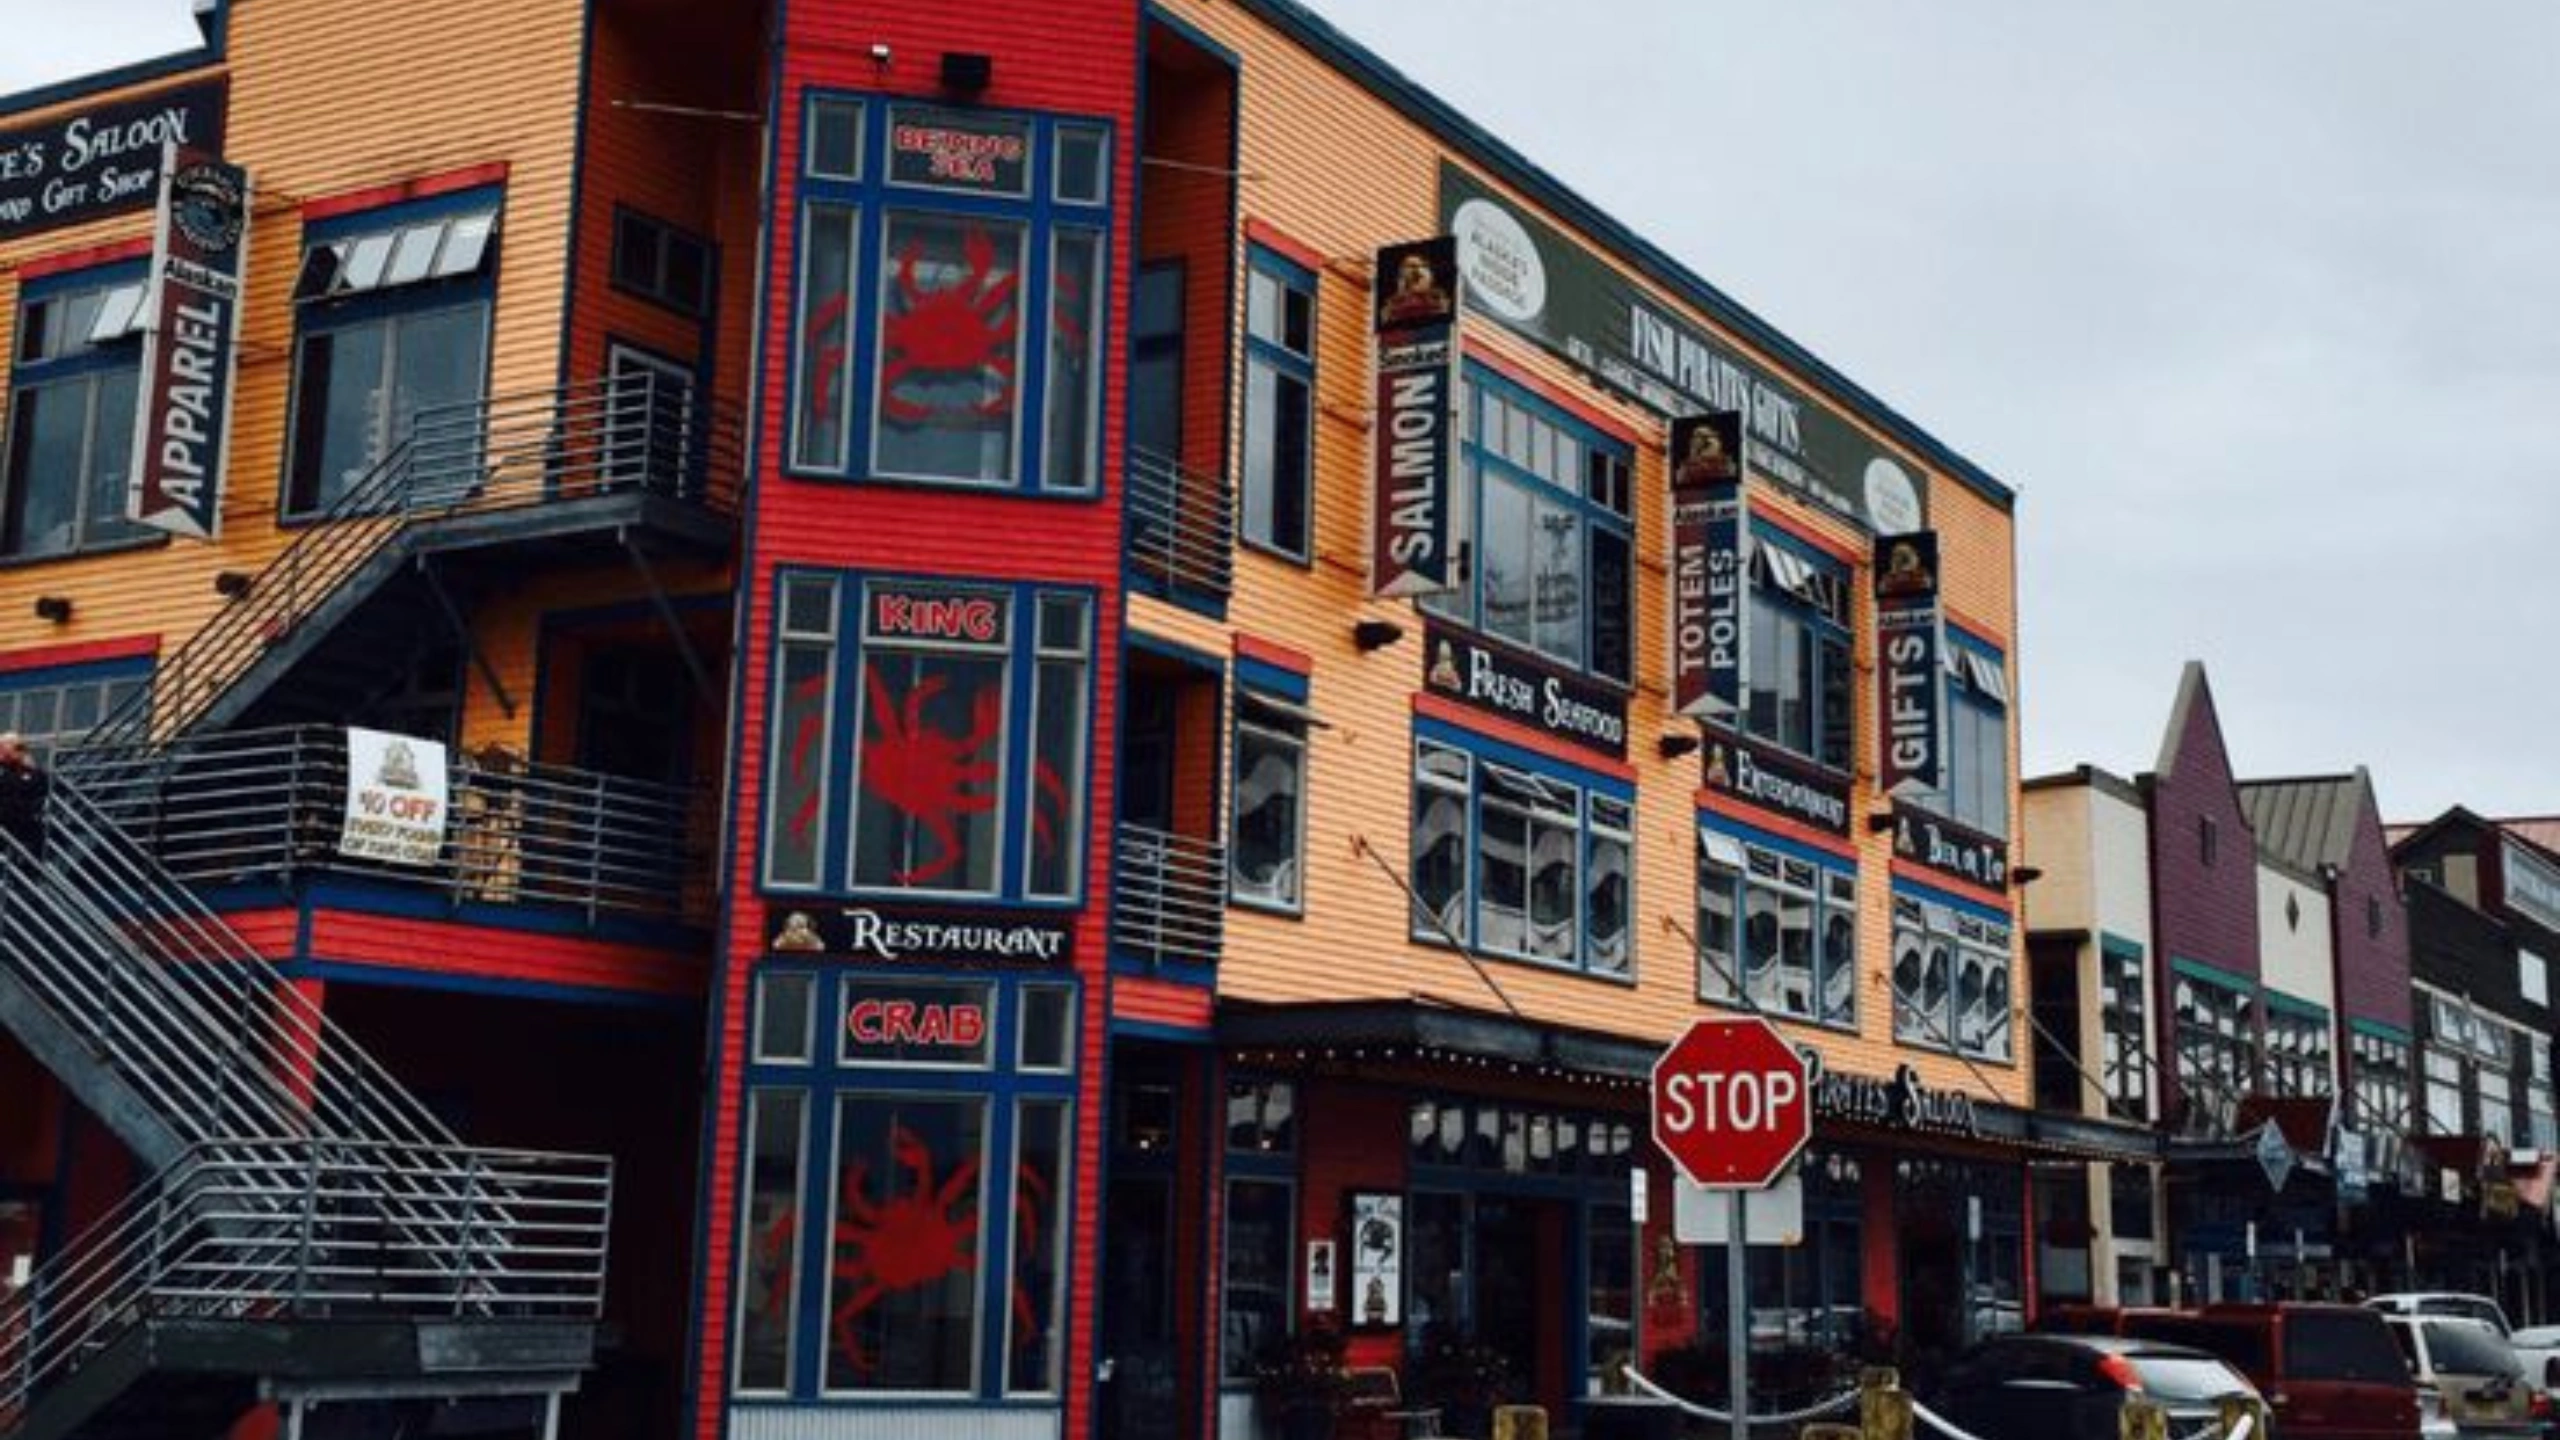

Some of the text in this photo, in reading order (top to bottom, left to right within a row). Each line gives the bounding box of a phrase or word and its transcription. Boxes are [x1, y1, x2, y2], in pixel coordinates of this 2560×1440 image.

[0, 108, 189, 180] E'S SALOON
[42, 177, 89, 214] GIFT
[98, 165, 155, 202] SHOP
[160, 302, 221, 509] APPAREL
[1390, 374, 1437, 565] SALMON
[878, 593, 997, 642] KING
[1679, 545, 1706, 676] TOTEM
[1709, 548, 1738, 670] POLES
[1467, 647, 1622, 745] FRESH SEAFOOD
[1888, 635, 1930, 771] GIFTS
[389, 795, 438, 824] OFF
[841, 907, 1067, 960] RESTAURANT
[850, 999, 985, 1046] CRAB
[1665, 1070, 1797, 1132] STOP
